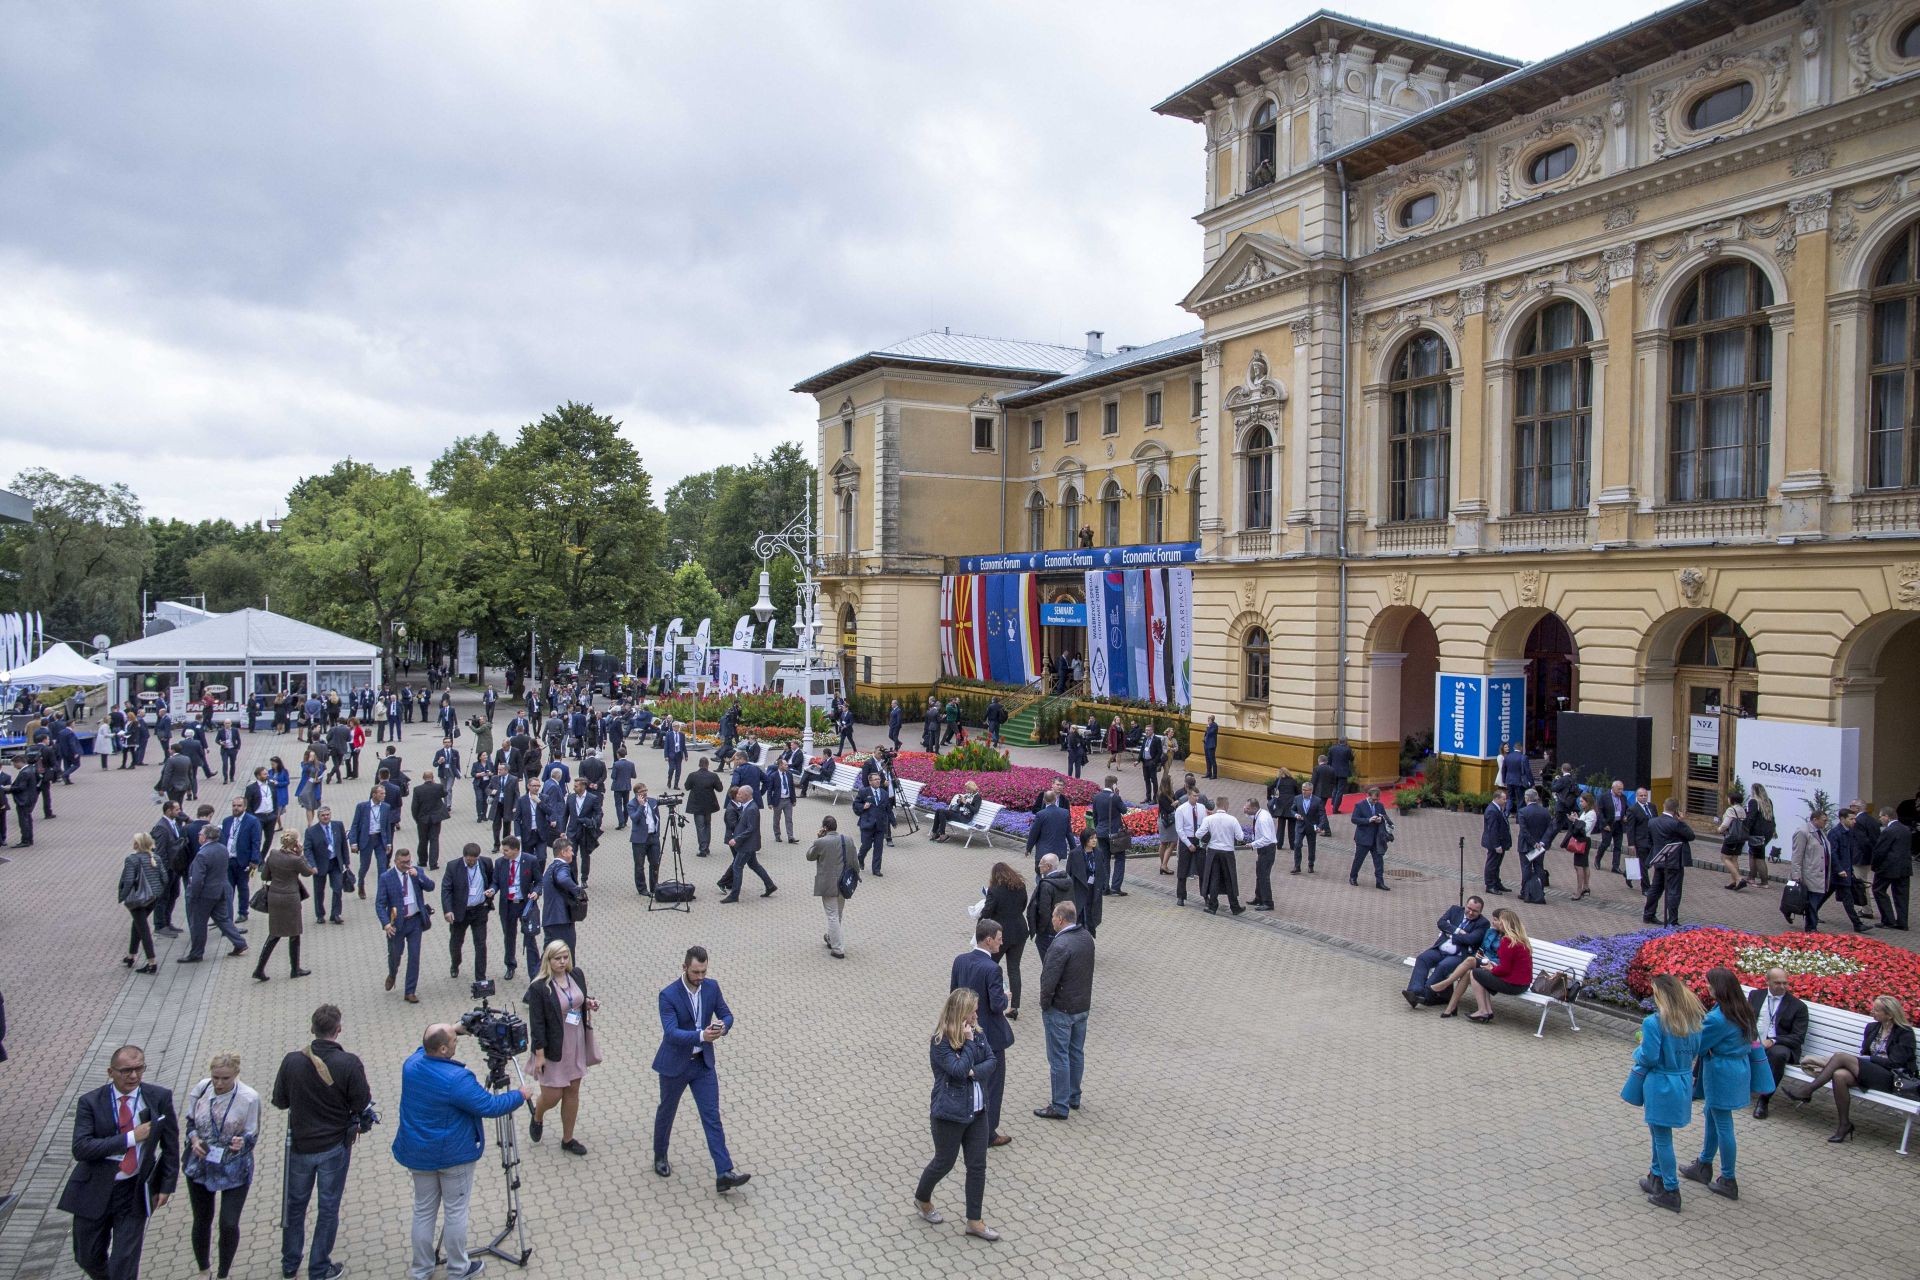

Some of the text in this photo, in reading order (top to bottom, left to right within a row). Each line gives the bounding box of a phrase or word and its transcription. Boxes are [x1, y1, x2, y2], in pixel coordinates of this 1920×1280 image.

[980, 557, 1021, 570] Economic Forum
[1045, 554, 1093, 567] Economic Forum
[1122, 549, 1182, 564] Economic Forum
[1054, 606, 1074, 615] SEMINARS
[1177, 571, 1185, 653] PODKARPACKIE
[187, 703, 238, 712] FA24.PL
[1498, 682, 1511, 743] eminars
[1451, 681, 1465, 749] seminars
[1696, 720, 1713, 729] NFZ
[1752, 761, 1822, 778] POLSKA2041
